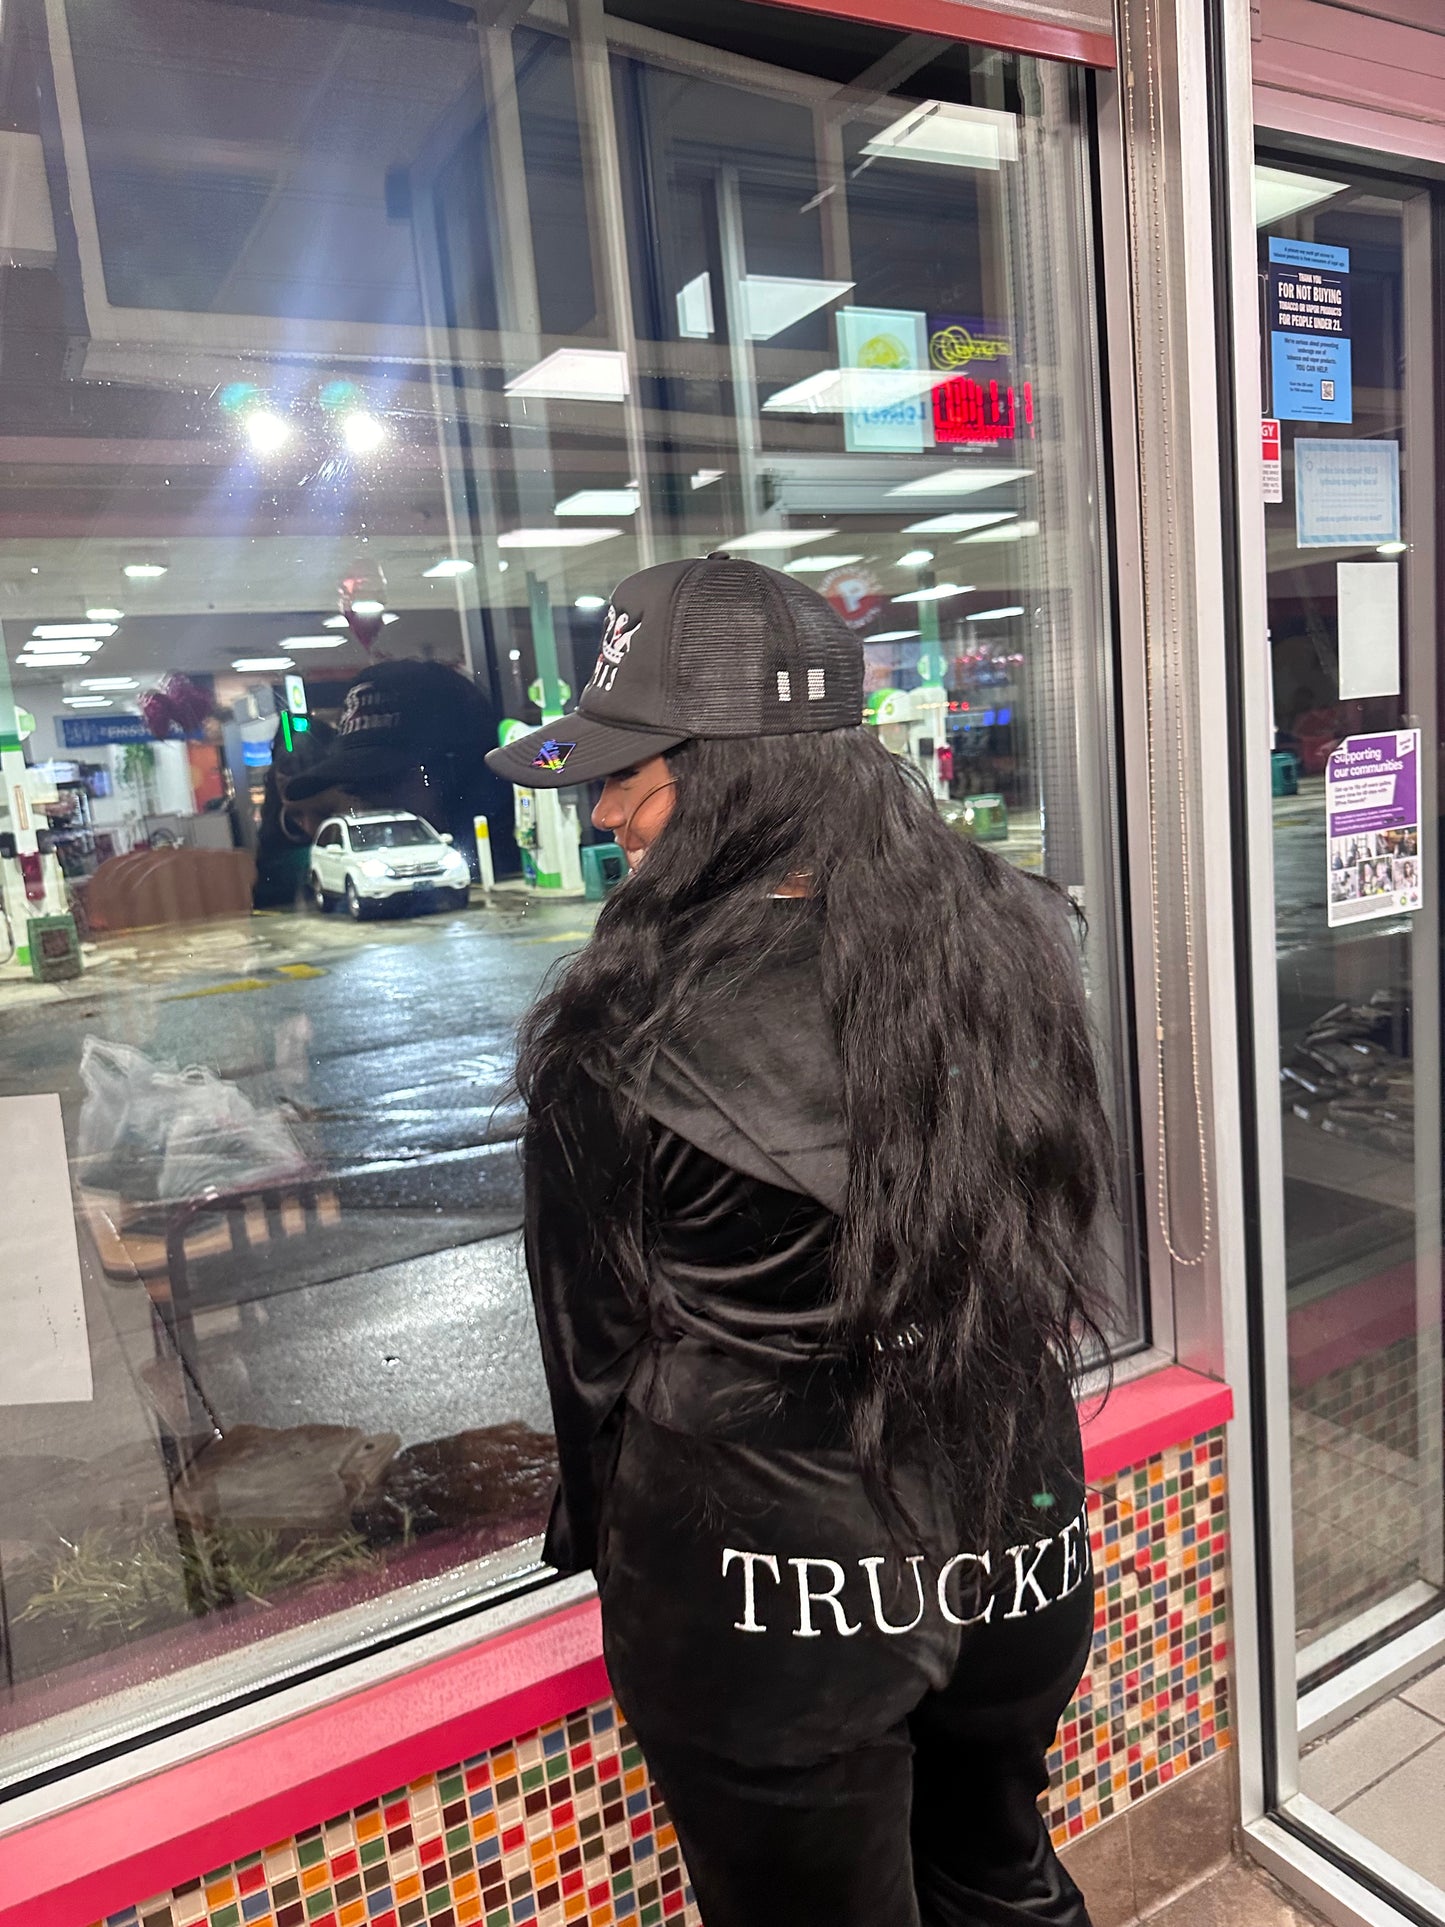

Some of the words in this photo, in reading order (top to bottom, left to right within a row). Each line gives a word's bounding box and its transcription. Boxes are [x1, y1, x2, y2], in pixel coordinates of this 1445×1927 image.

[1278, 282, 1294, 298] FOR
[1296, 284, 1312, 300] NOT
[1313, 286, 1342, 304] BUYING
[1279, 312, 1291, 326] FOR
[1292, 314, 1313, 328] PEOPLE
[1314, 317, 1332, 330] UNDER
[1333, 747, 1382, 764] Supporting
[1333, 768, 1349, 778] our
[1350, 759, 1404, 776] communities
